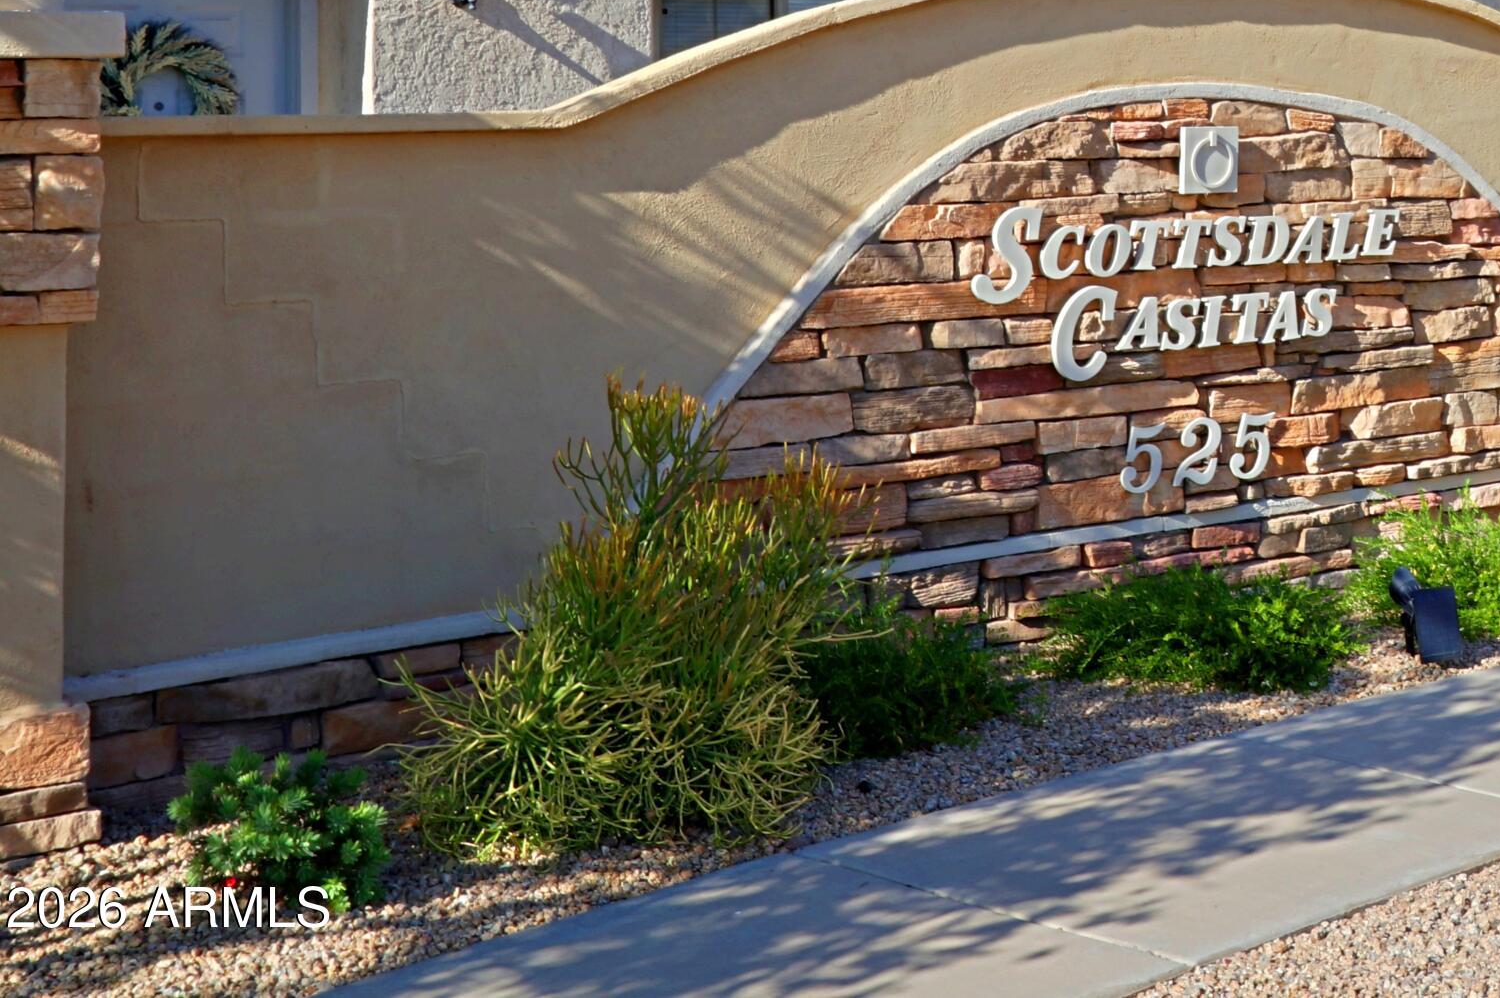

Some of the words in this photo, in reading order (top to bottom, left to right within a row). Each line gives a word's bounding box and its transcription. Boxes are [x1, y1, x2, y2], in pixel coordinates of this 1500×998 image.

[971, 206, 1400, 304] SCOTTSDALE
[1051, 285, 1337, 381] CASITAS
[1120, 412, 1277, 494] 525
